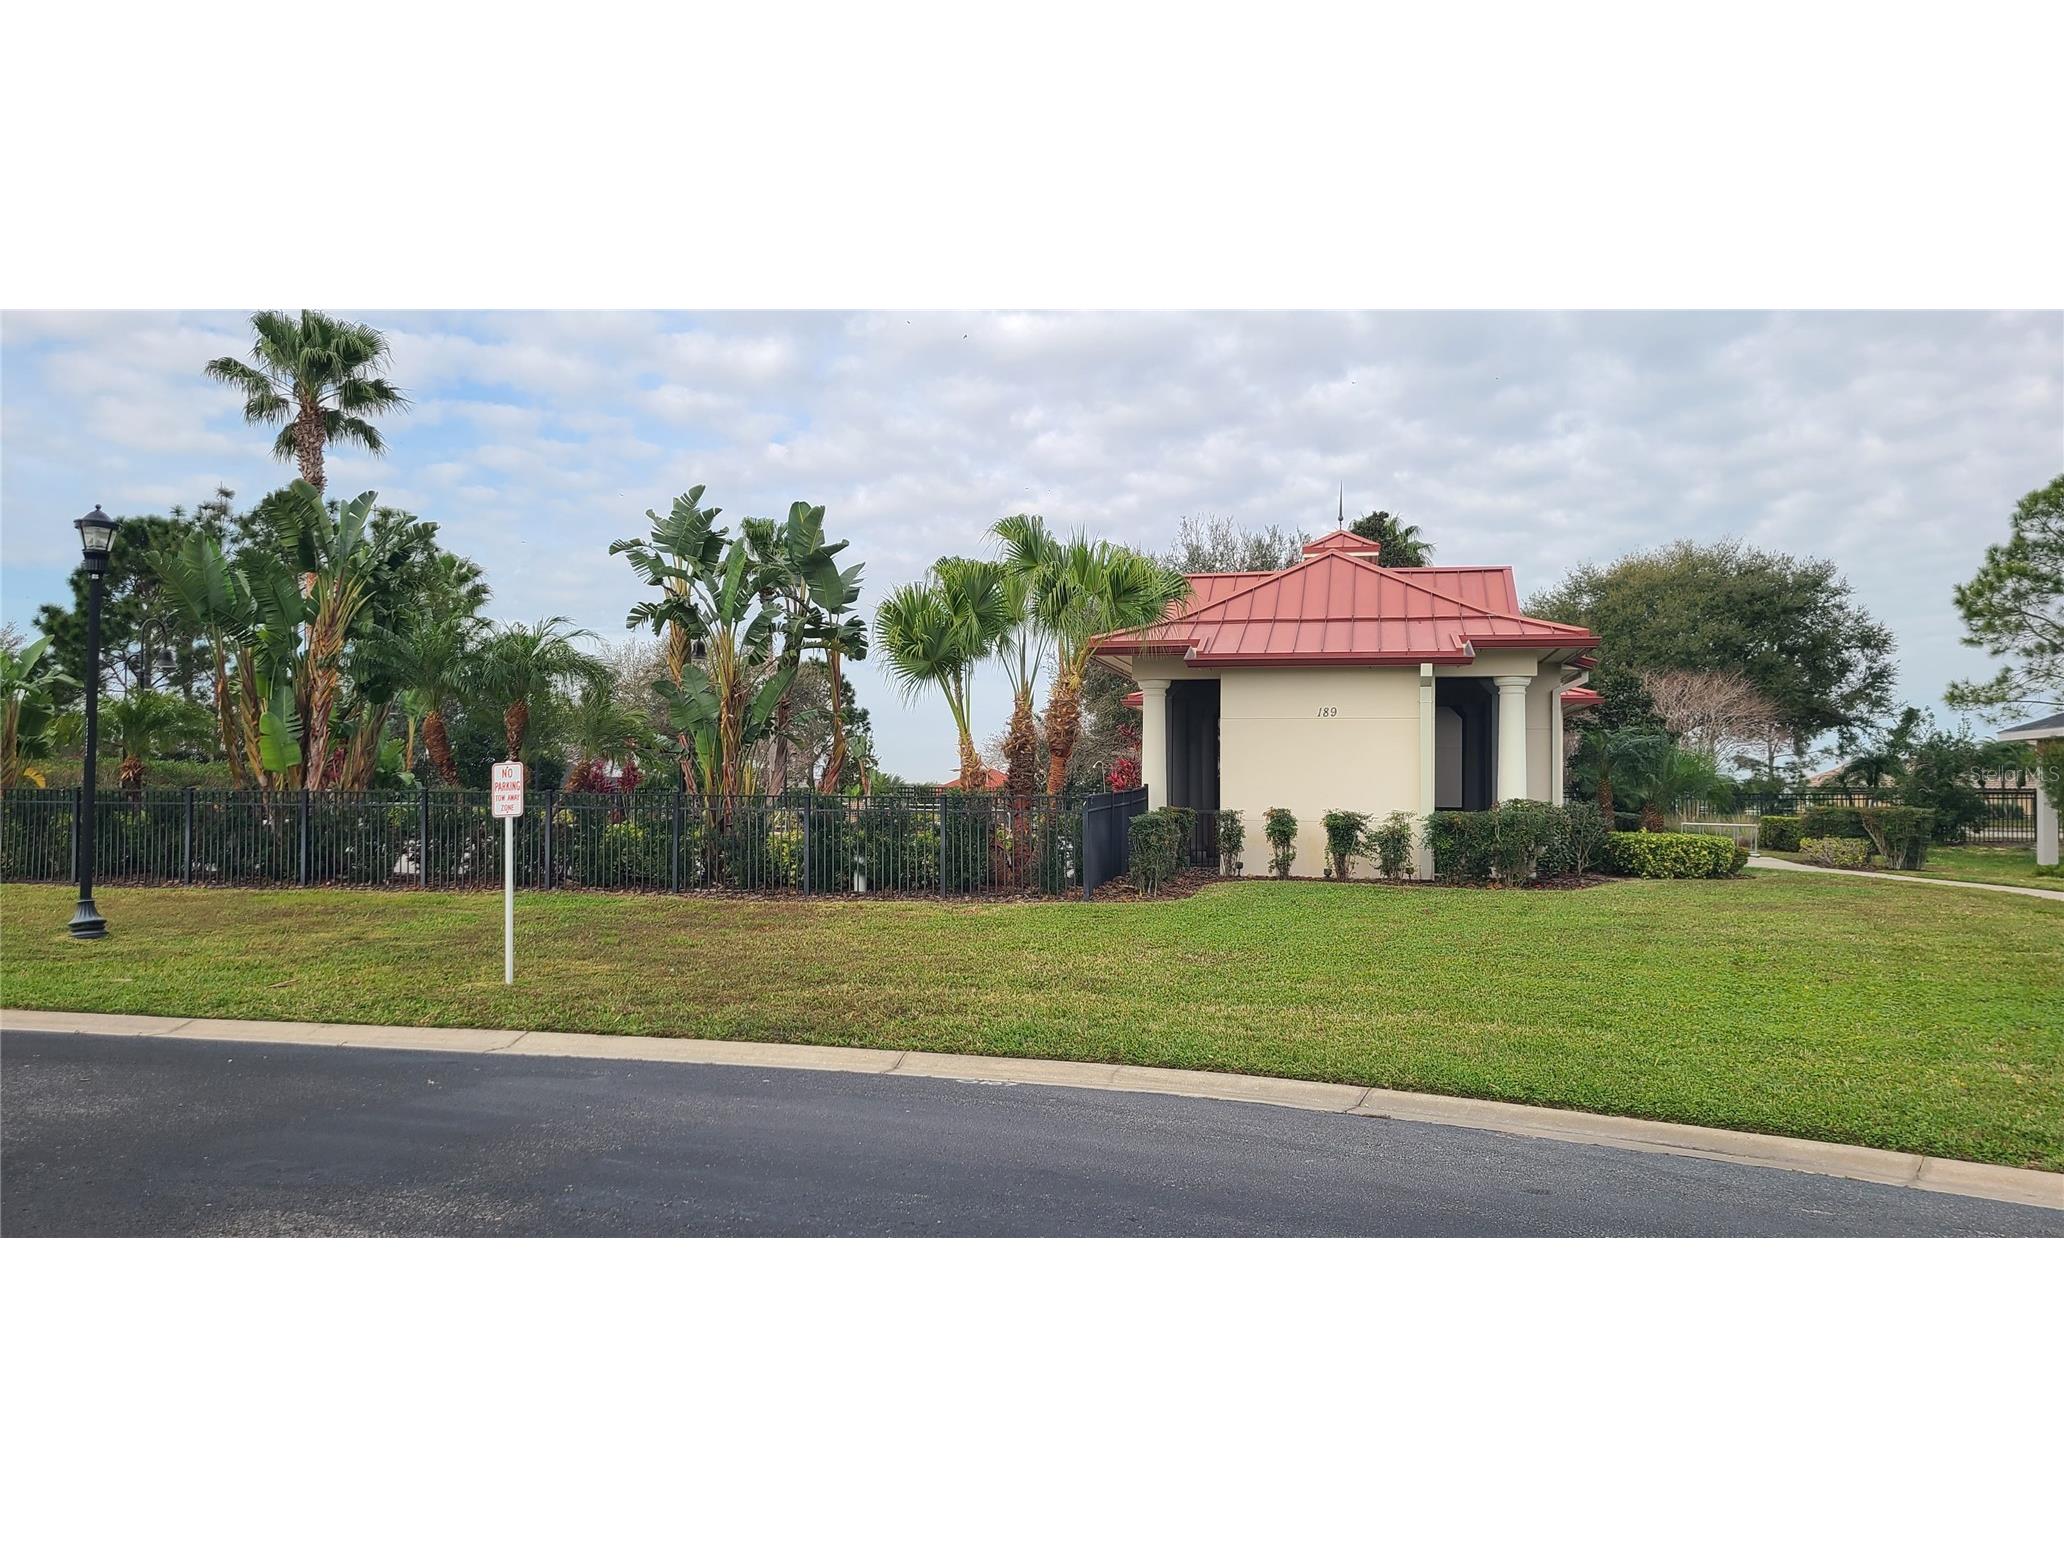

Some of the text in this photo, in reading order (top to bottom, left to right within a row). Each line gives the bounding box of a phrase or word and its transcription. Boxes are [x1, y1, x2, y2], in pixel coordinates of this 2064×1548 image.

[1317, 707, 1337, 717] 189
[502, 768, 513, 778] NO
[495, 780, 521, 792] PARKING
[496, 794, 505, 802] TOW
[501, 804, 514, 812] ZONE
